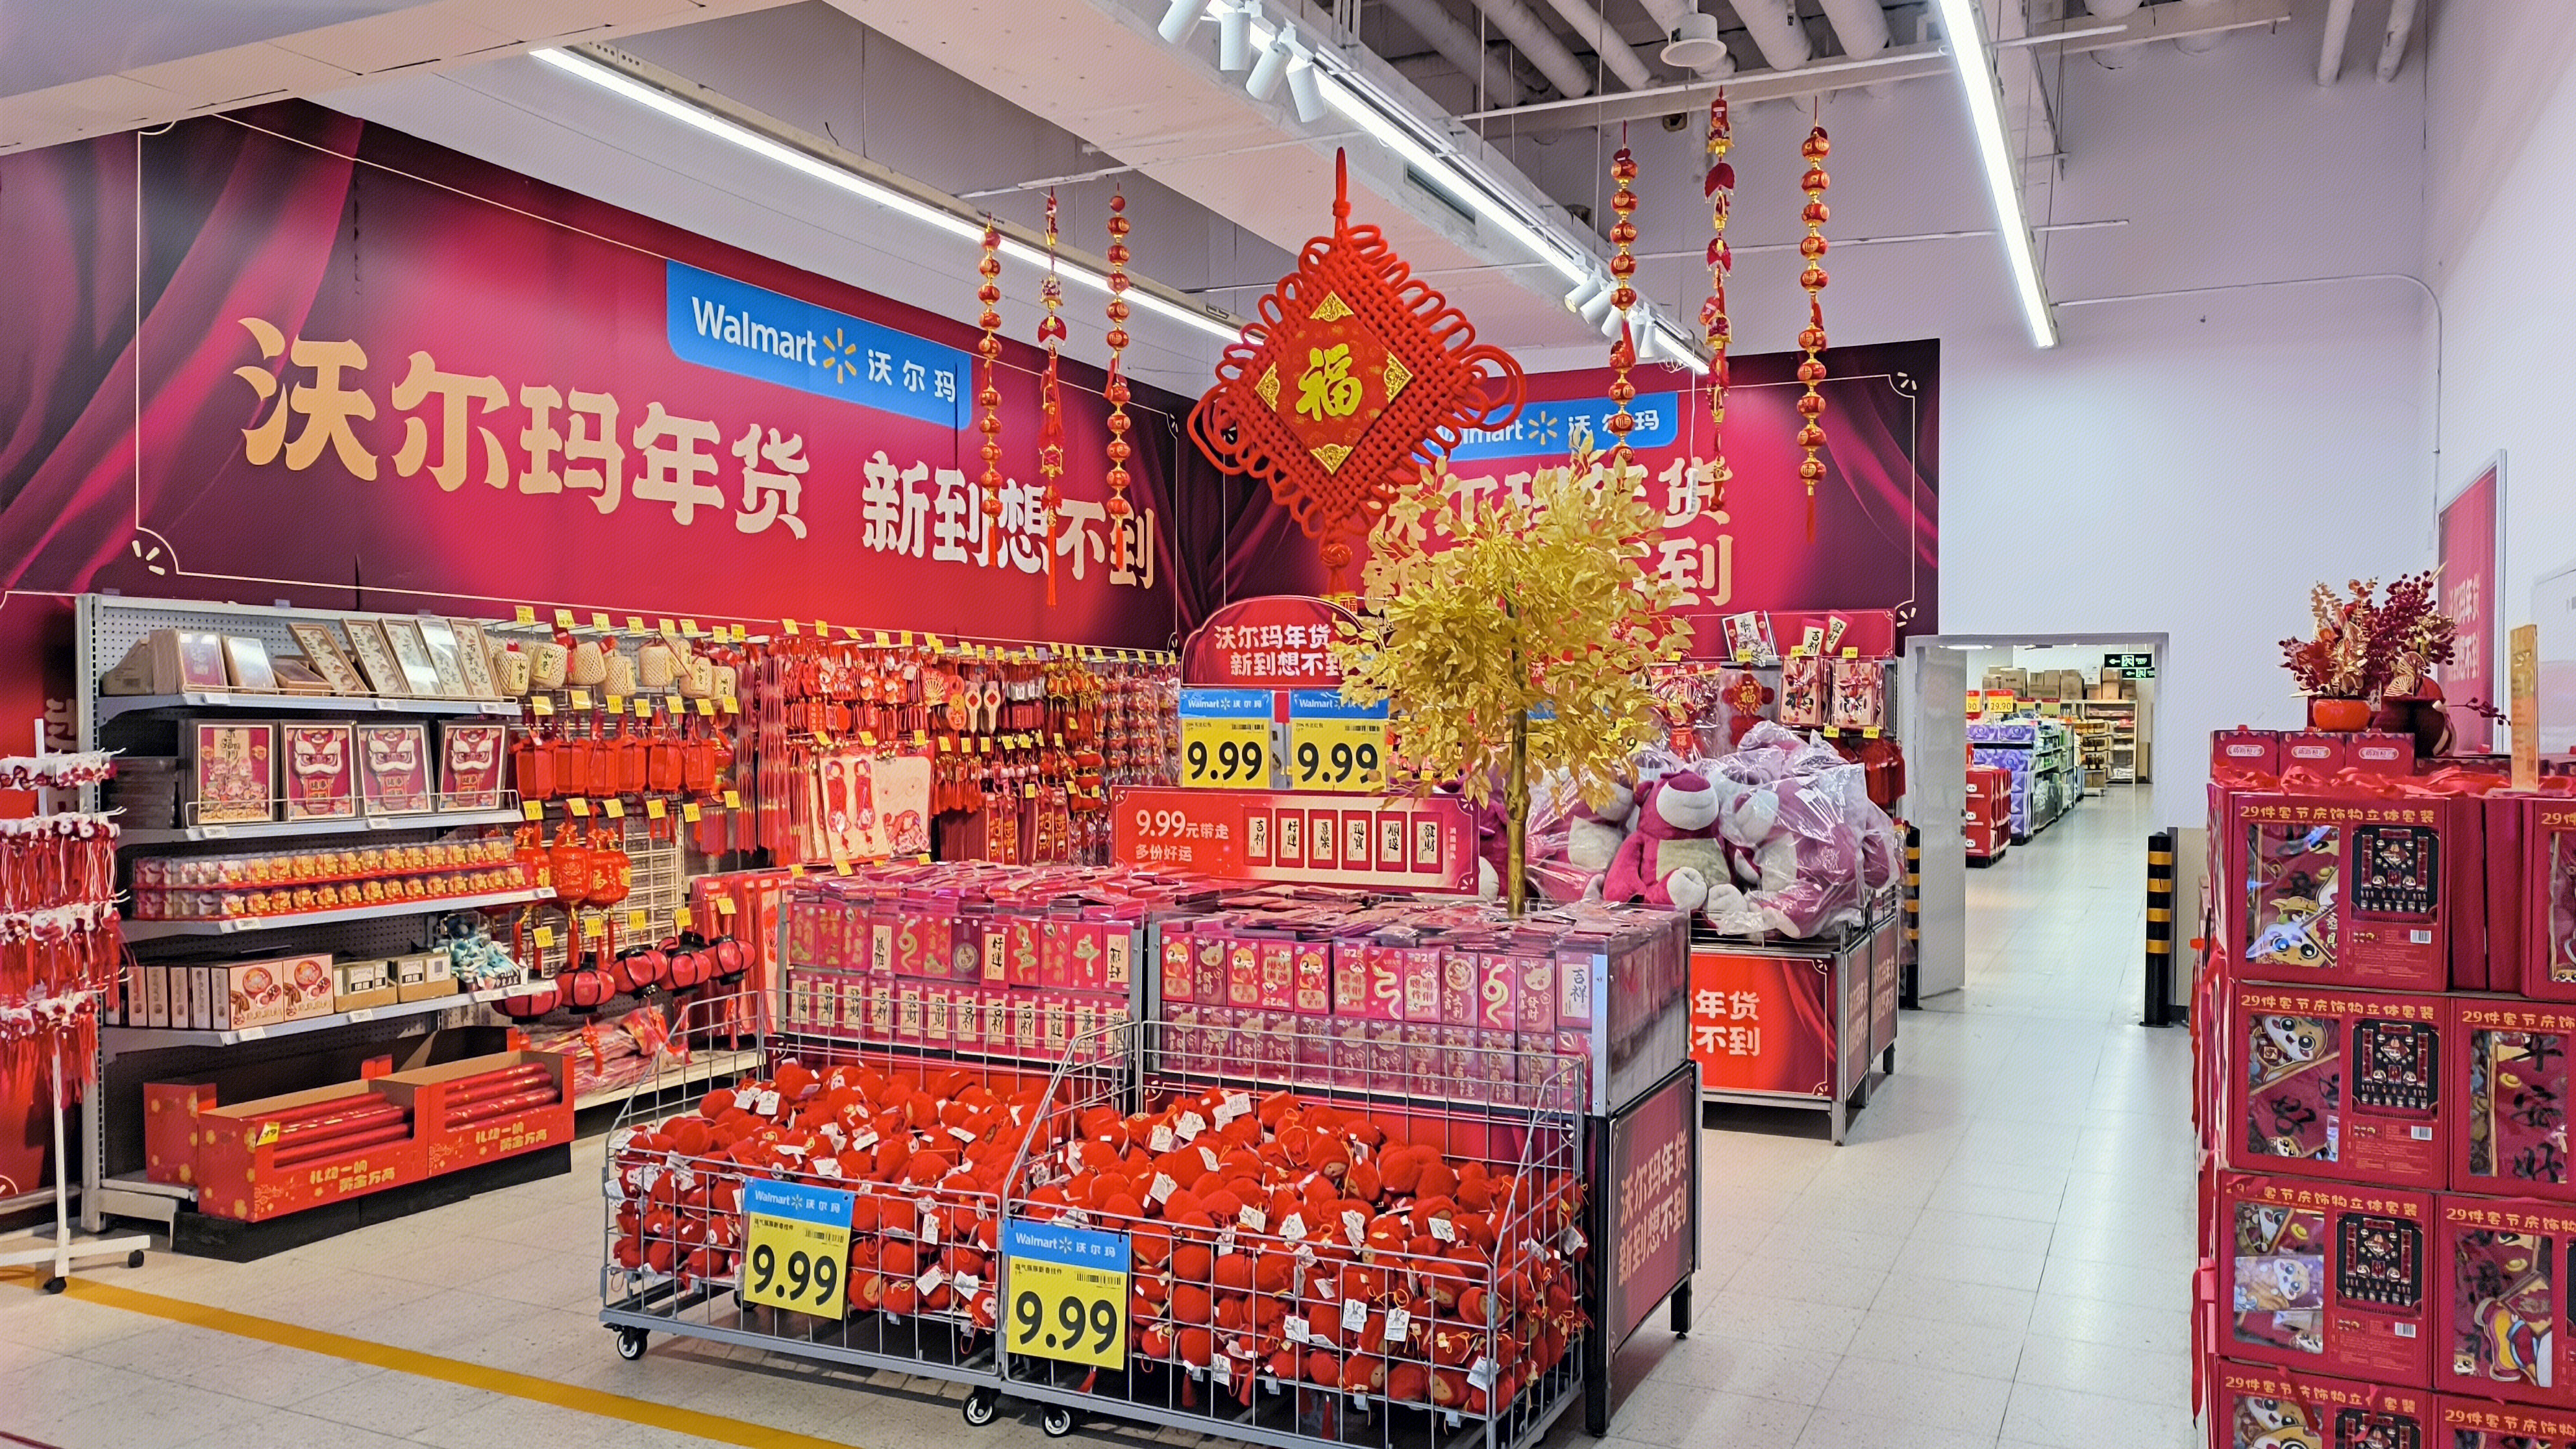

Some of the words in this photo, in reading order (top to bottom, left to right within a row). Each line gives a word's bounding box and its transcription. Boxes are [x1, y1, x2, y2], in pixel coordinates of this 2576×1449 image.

[692, 297, 817, 367] Walmart
[868, 349, 956, 404] 沃尔玛
[1295, 343, 1363, 421] 福
[1434, 419, 1523, 446] lmart
[234, 317, 810, 541] 沃尔玛年货
[862, 449, 1154, 589] 新到想不到
[1215, 624, 1332, 650] 沃尔玛年货
[1230, 651, 1345, 678] 新到想不到
[1188, 697, 1219, 709] Walmart
[1300, 698, 1333, 710] Walmart
[1187, 741, 1262, 781] 9.99
[1298, 742, 1378, 784] 9.99
[1135, 810, 1229, 840] 9.99元带走
[2240, 806, 2434, 823] 29件套节庆饰物立体套装
[1135, 845, 1193, 863] 多份好运
[1690, 989, 1761, 1021] 年货
[2241, 995, 2434, 1021] 29件套节庆饰物立体套装
[1690, 1026, 1761, 1057] 不到
[1620, 1128, 1687, 1228] 沃尔玛年货
[755, 1190, 790, 1206] Walmart
[806, 1198, 841, 1214] 沃尔玛
[1015, 1232, 1058, 1249] Walmart
[1076, 1241, 1116, 1258] 沃尔玛
[1618, 1183, 1687, 1287] 新到想不到
[752, 1243, 838, 1307] 9.99
[1016, 1290, 1118, 1355] 9.99
[2225, 1376, 2416, 1414] 29件套节庆饰物立套装
